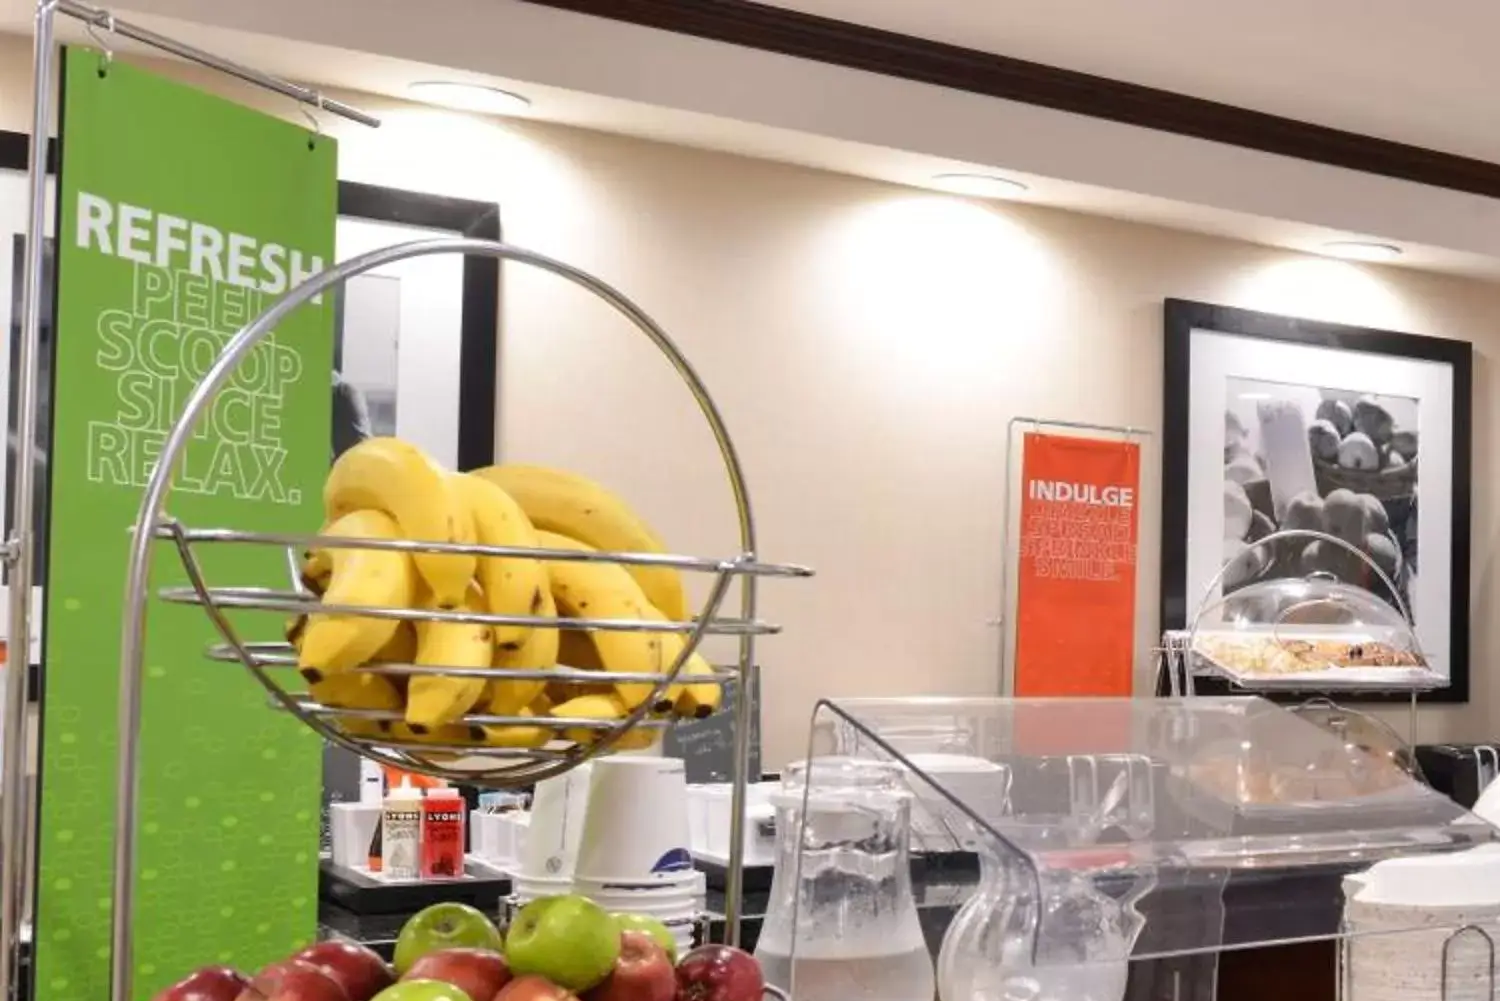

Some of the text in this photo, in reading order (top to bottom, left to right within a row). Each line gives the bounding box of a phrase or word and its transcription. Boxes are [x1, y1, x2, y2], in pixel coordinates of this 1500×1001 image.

[76, 191, 323, 305] REFRESH
[132, 261, 275, 346] PEEL
[96, 309, 302, 399] SCOOP
[87, 420, 302, 505] RELAX.
[1029, 480, 1133, 508] INDULGE
